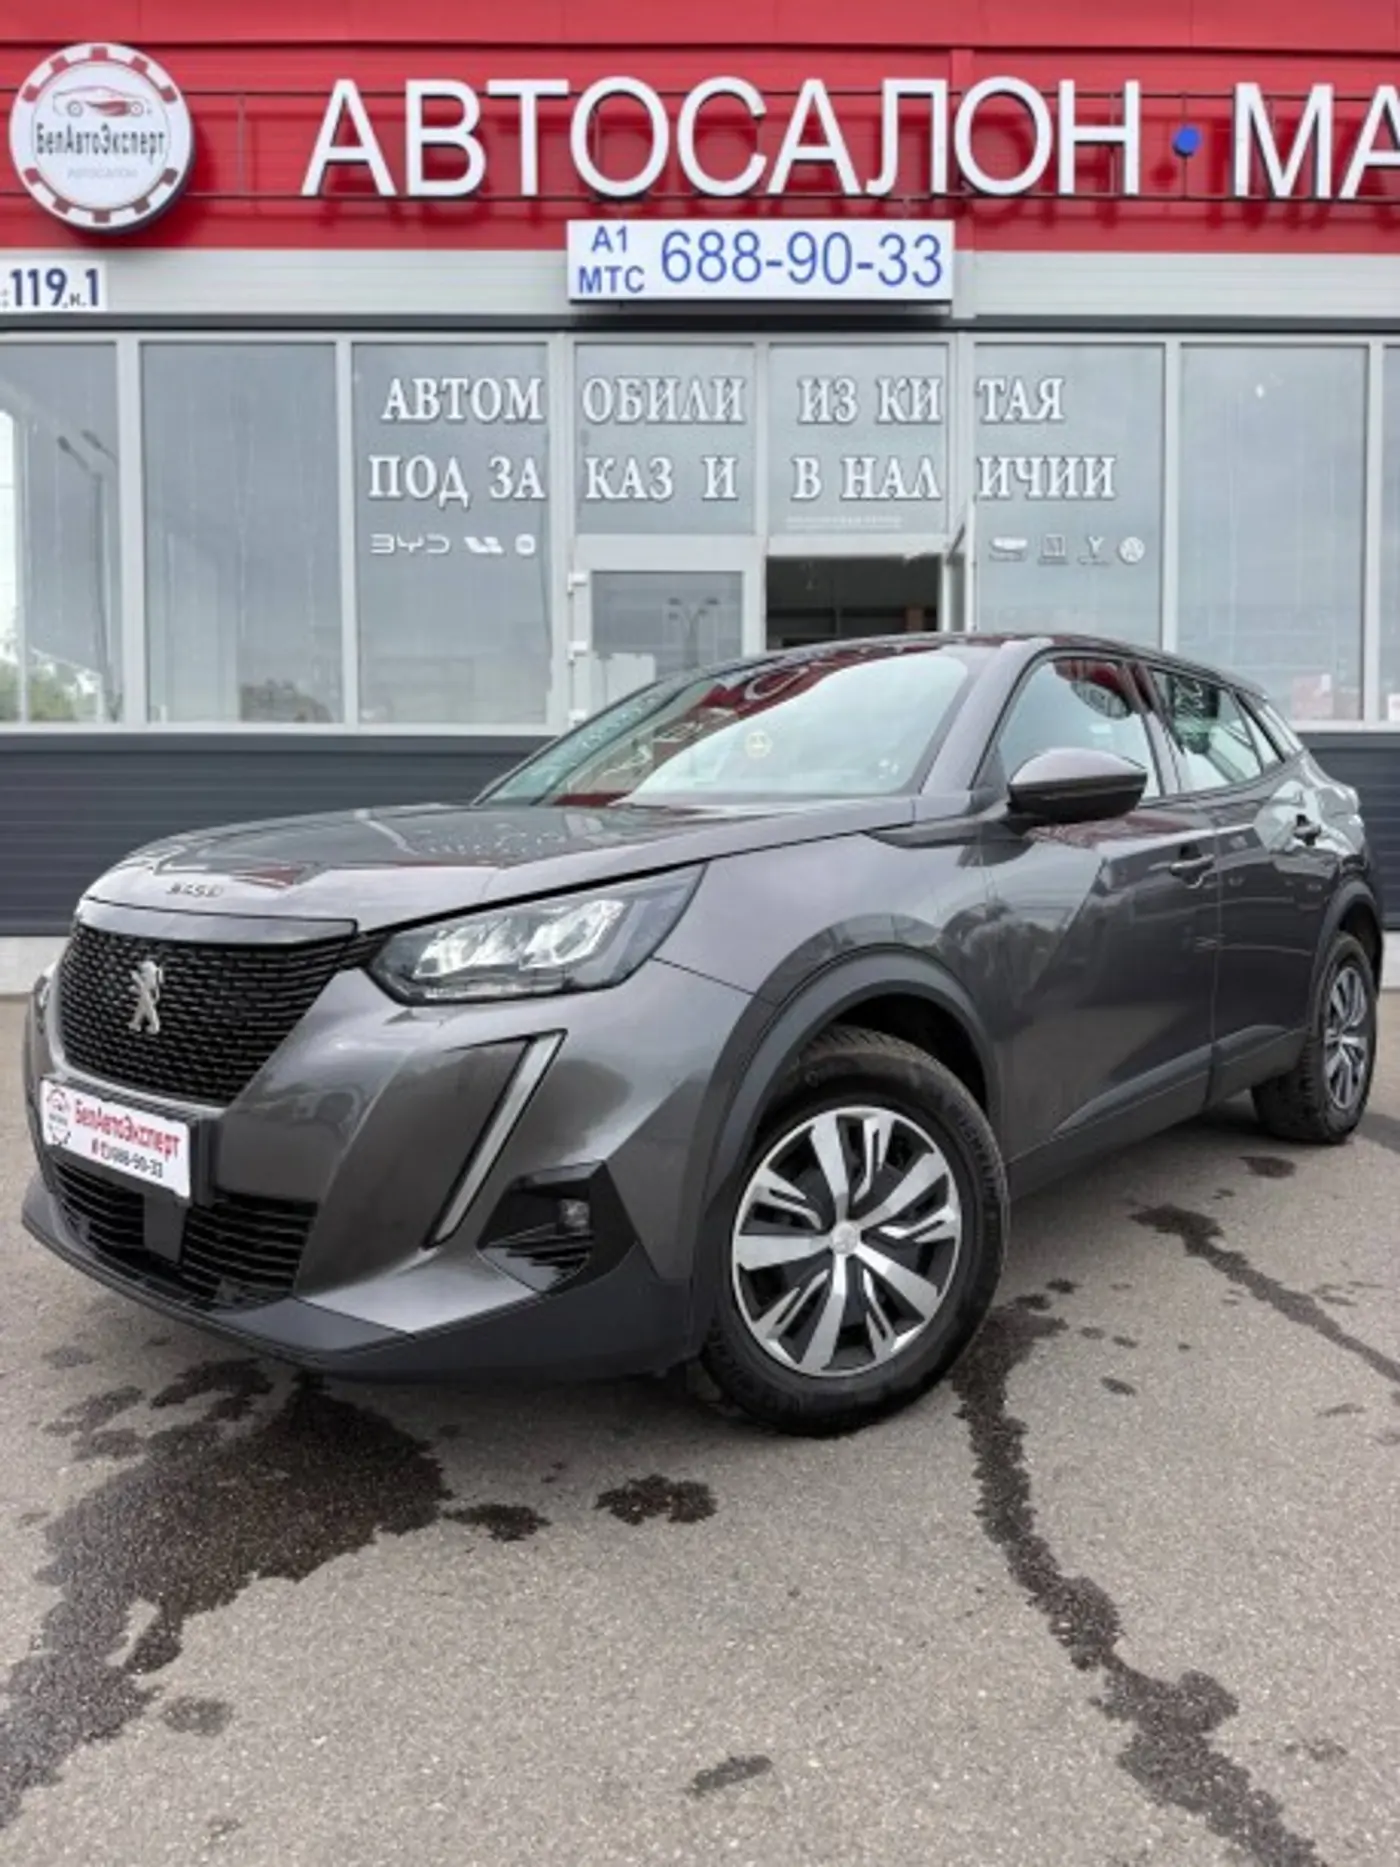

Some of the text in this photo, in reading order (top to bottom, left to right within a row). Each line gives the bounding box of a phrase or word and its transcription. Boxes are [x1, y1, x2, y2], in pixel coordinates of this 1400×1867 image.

[36, 122, 165, 165] БелАвтоЭксперт
[301, 76, 1400, 199] АВТОСАЛОН МА
[577, 264, 646, 295] МТС
[660, 229, 944, 288] 688-90-33
[798, 377, 858, 424] ИЗ
[368, 455, 470, 509] ПОД
[702, 456, 739, 500] И
[792, 456, 822, 500] В
